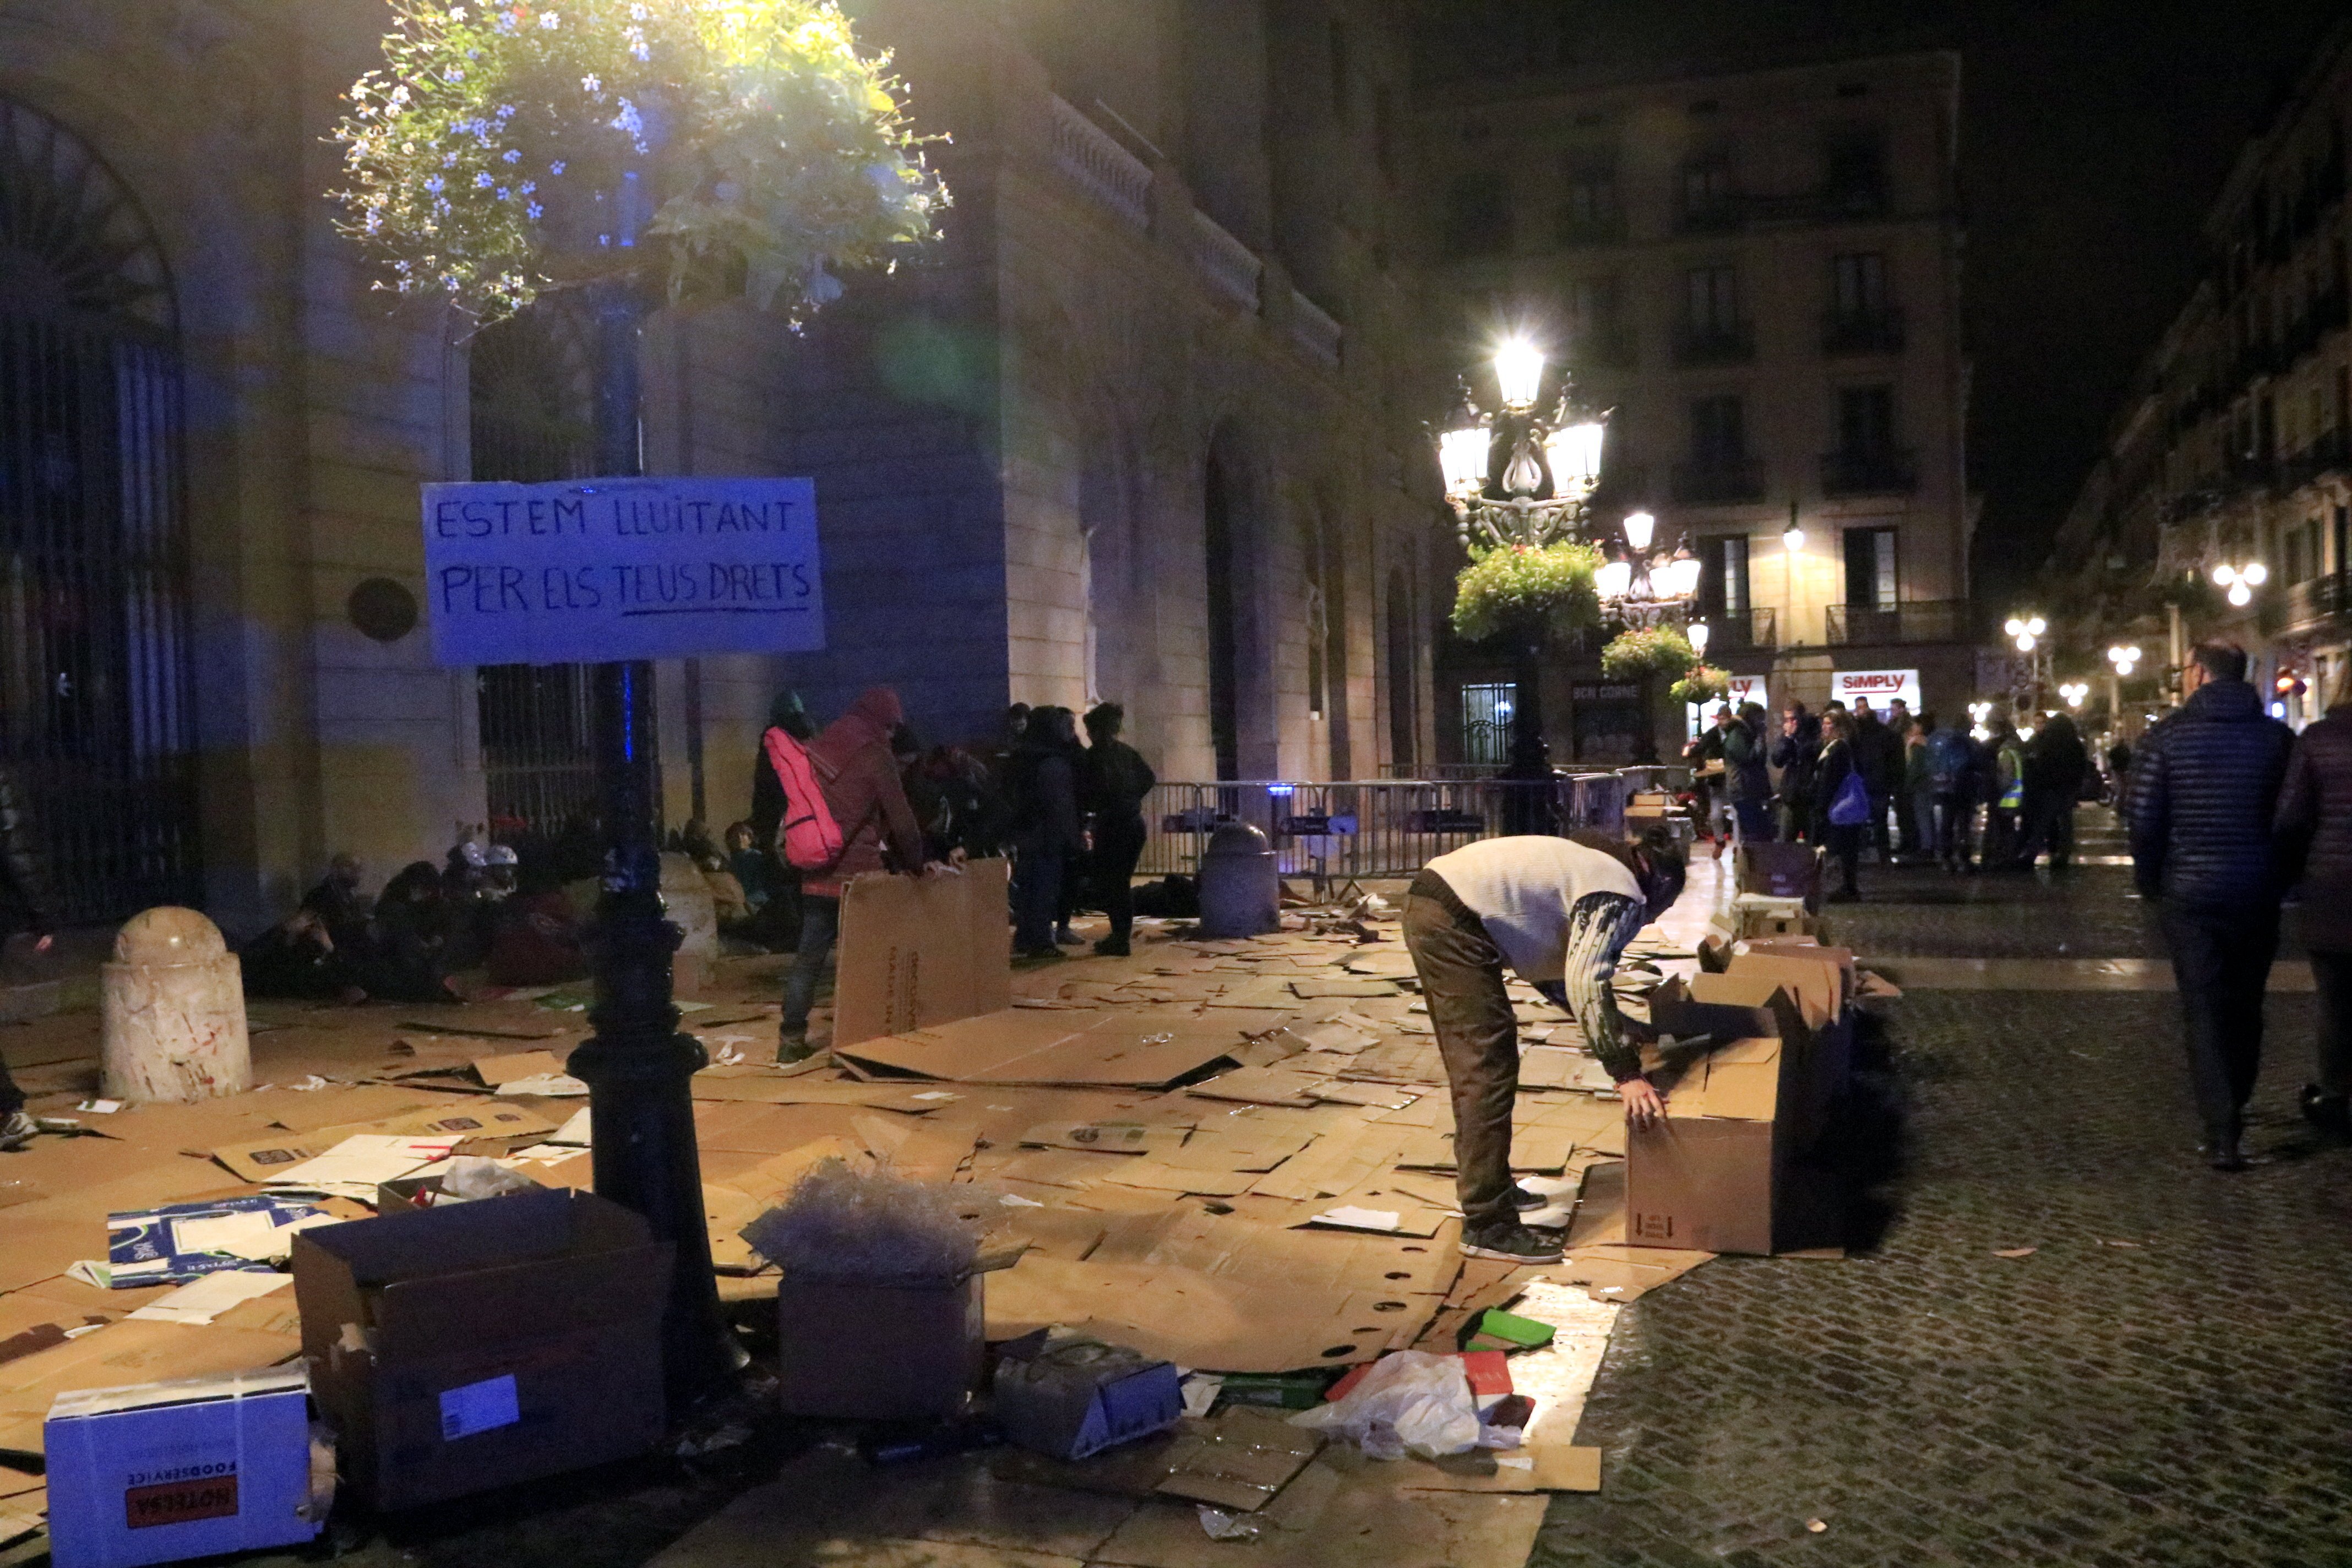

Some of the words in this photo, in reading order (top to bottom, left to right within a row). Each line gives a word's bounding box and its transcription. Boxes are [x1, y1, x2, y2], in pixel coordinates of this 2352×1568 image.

[436, 498, 586, 538] ESTEM
[440, 565, 528, 614] PER
[612, 563, 698, 604] TEUS
[709, 562, 811, 601] DRETS
[127, 1461, 236, 1485] FOODSERVICE
